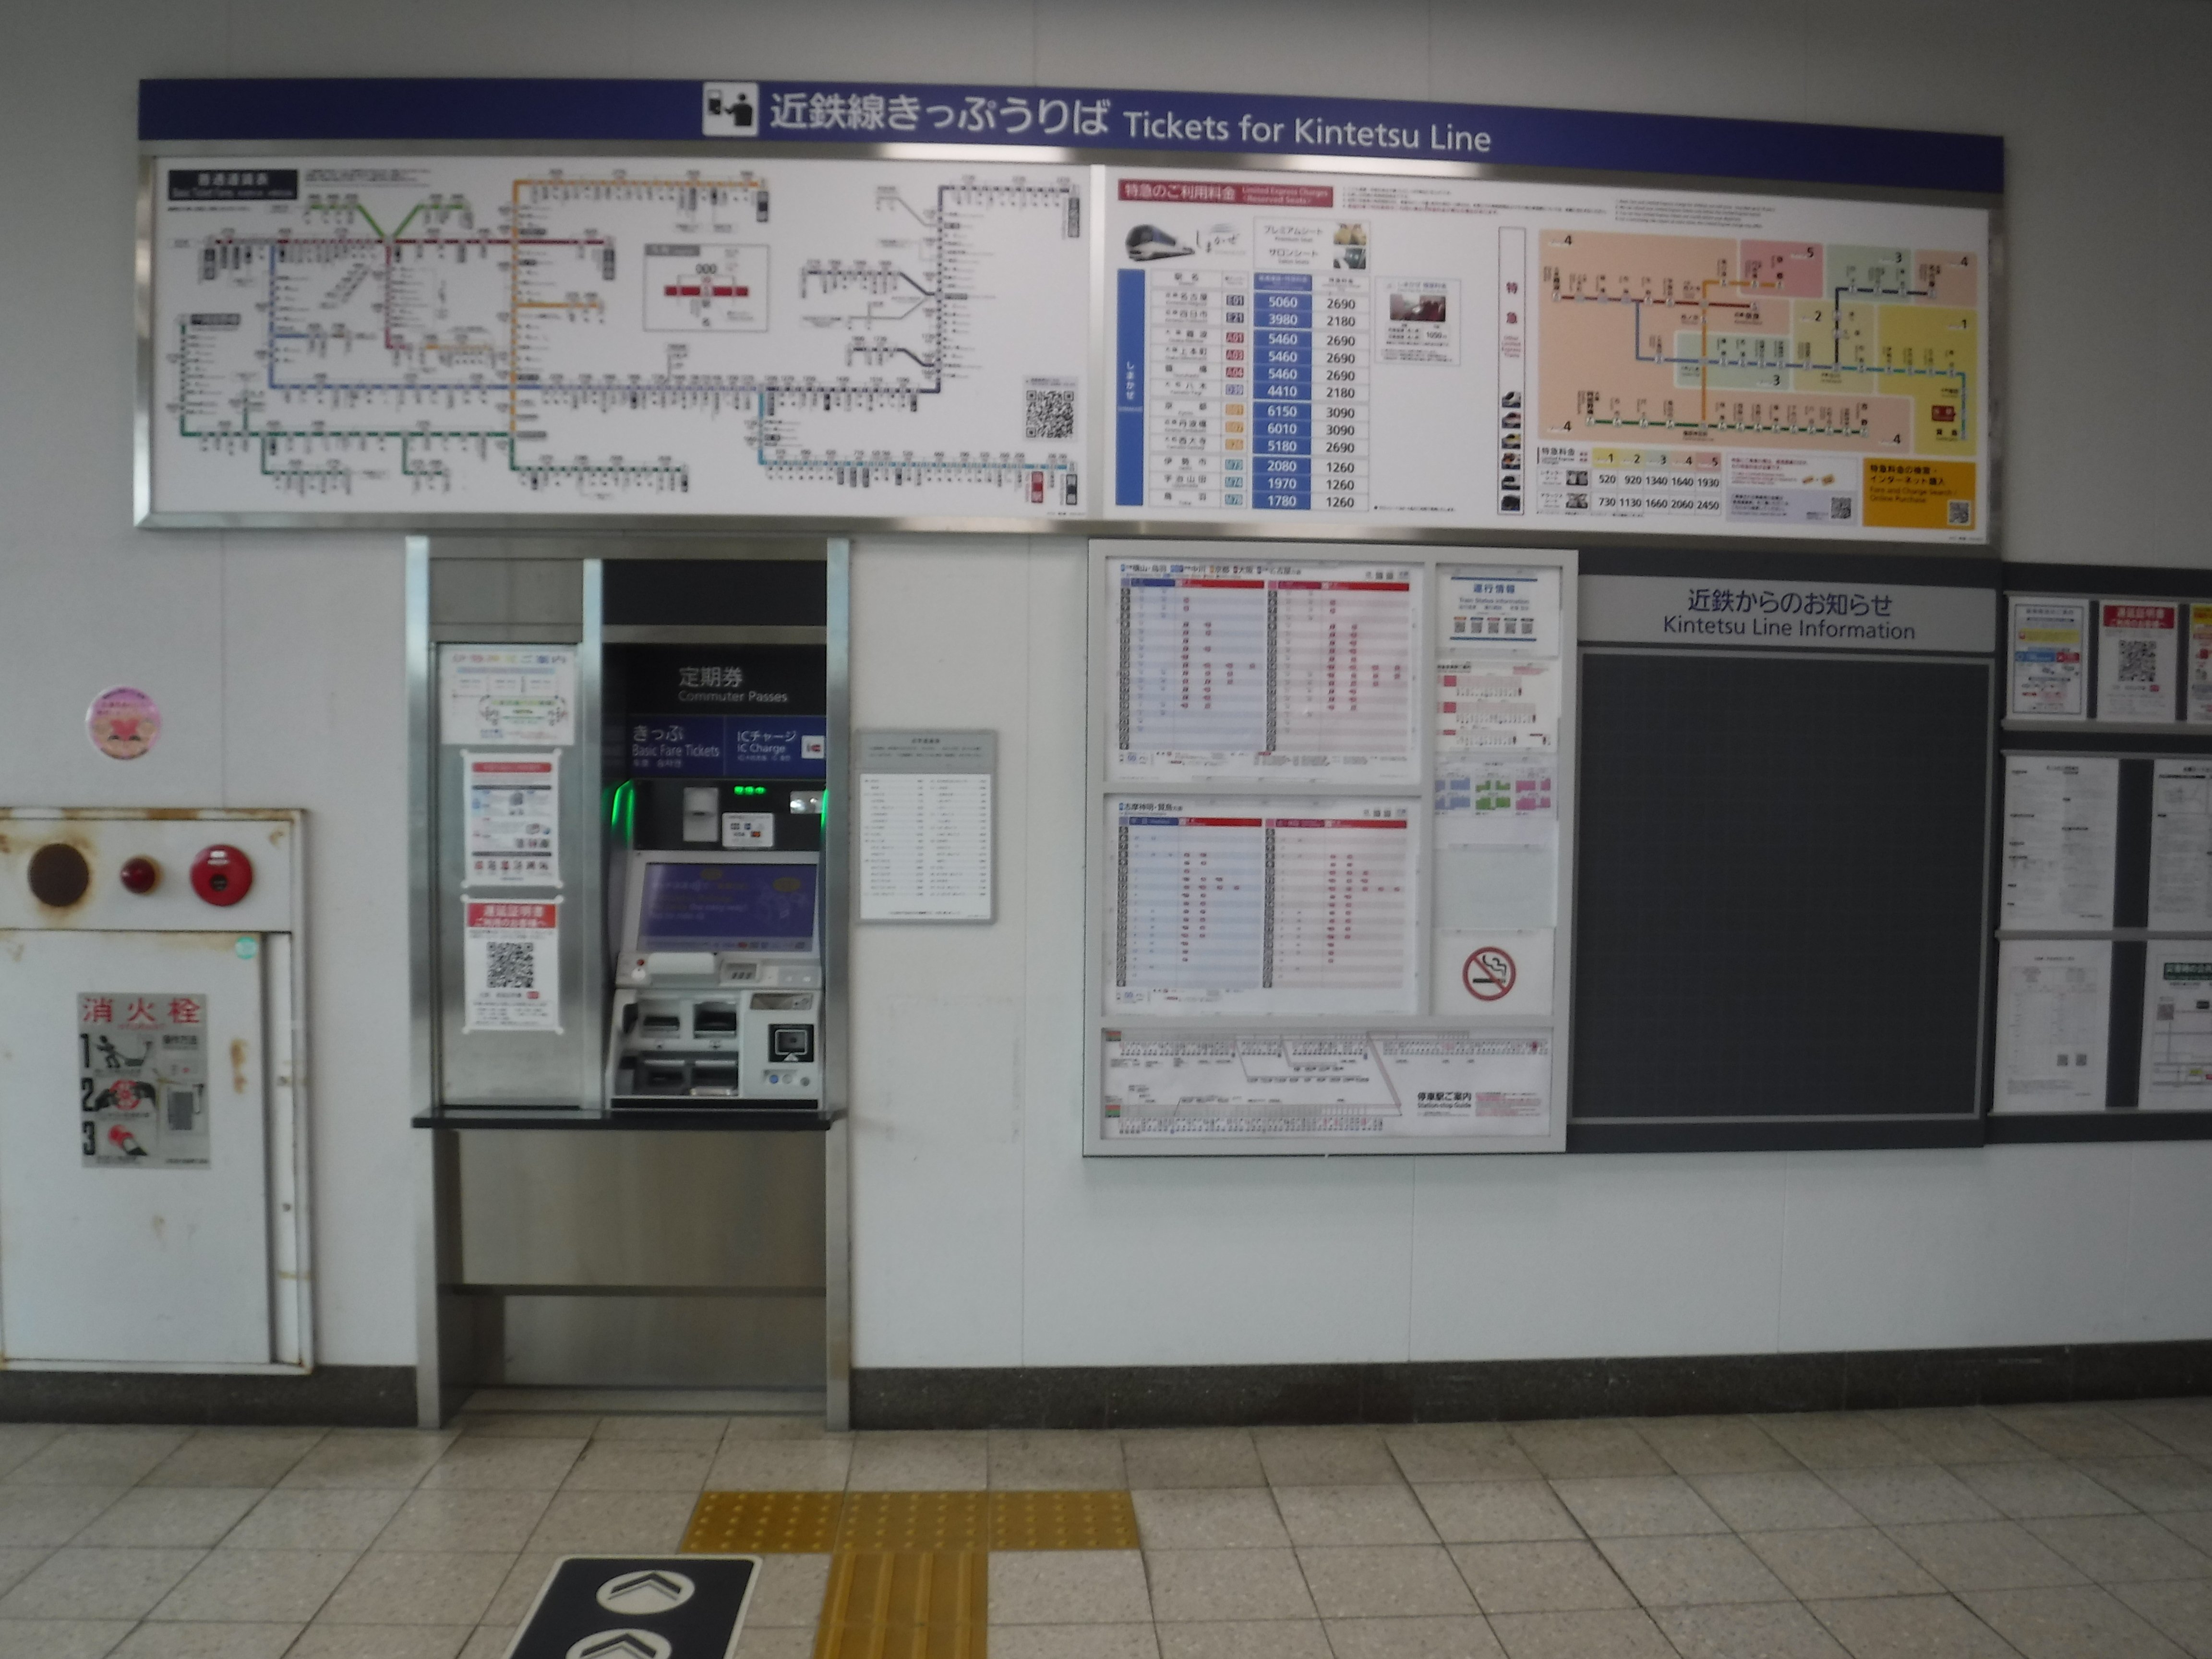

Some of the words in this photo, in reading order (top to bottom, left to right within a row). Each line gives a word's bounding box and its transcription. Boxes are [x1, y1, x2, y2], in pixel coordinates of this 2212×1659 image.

[770, 93, 1111, 135] 近鉄線きっぷうりば
[1124, 111, 1229, 140] Tickets
[1238, 114, 1285, 143] for
[1294, 119, 1420, 148] Kintetsu
[1431, 124, 1491, 153] Line
[1564, 235, 1572, 245] 4
[1807, 247, 1814, 258] 5
[1896, 252, 1902, 263] 3
[1961, 257, 1968, 266] 4
[1269, 297, 1298, 308] 5060
[1327, 299, 1355, 309] 2690
[1269, 313, 1298, 325] 3980
[1327, 316, 1355, 326] 2180
[1815, 311, 1821, 321] 2
[1962, 320, 1967, 329] 1
[1269, 334, 1298, 345] 5460
[1326, 336, 1355, 346] 2690
[1268, 351, 1298, 362] 5460
[1326, 353, 1355, 364] 2690
[1268, 368, 1297, 380] 5460
[1326, 370, 1355, 381] 2690
[1773, 375, 1780, 386] 3
[1267, 385, 1297, 397] 4410
[1326, 387, 1355, 398] 2180
[1267, 406, 1297, 417] 6150
[1326, 407, 1355, 418] 3090
[1267, 422, 1297, 434] 6010
[1326, 424, 1355, 436] 3090
[1563, 421, 1572, 431] 4
[1893, 434, 1900, 444] 4
[1267, 440, 1297, 452] 5180
[1326, 442, 1355, 453] 2690
[1608, 453, 1613, 463] 1
[1634, 455, 1640, 464] 2
[1660, 455, 1666, 465] 3
[1686, 457, 1692, 465] 4
[1712, 457, 1718, 467] 5
[1267, 460, 1297, 472] 2080
[1326, 462, 1355, 473] 1260
[1268, 478, 1297, 489] 1970
[1599, 474, 1616, 484] 520
[1625, 475, 1641, 485] 920
[1646, 476, 1668, 485] 1340
[1672, 476, 1694, 486] 1640
[1698, 477, 1719, 487] 1930
[1326, 480, 1355, 490] 1260
[1268, 494, 1297, 506] 1780
[1326, 496, 1355, 508] 1260
[1599, 497, 1616, 506] 730
[1620, 498, 1642, 507] 1130
[1646, 499, 1668, 508] 1660
[1671, 499, 1694, 509] 2060
[1697, 500, 1719, 510] 2450
[1688, 589, 1893, 616] 近鉄からのお知らせ
[1663, 615, 1746, 635] Kintetsu
[1753, 618, 1791, 637] Line
[1799, 619, 1915, 640] Information
[679, 666, 743, 687] 定期券
[678, 690, 744, 702] Commuter
[749, 691, 789, 702] Passes
[633, 725, 684, 741] きっぷ
[737, 730, 796, 742] ICチャージ
[632, 745, 655, 756] Basic
[660, 745, 681, 757] Fare
[685, 745, 719, 757] Tickets
[737, 744, 747, 753] IC
[750, 744, 785, 754] Charge
[83, 997, 200, 1024] 消火栓
[80, 1033, 90, 1068] 1
[81, 1078, 96, 1112] 2
[82, 1121, 96, 1155] 3
